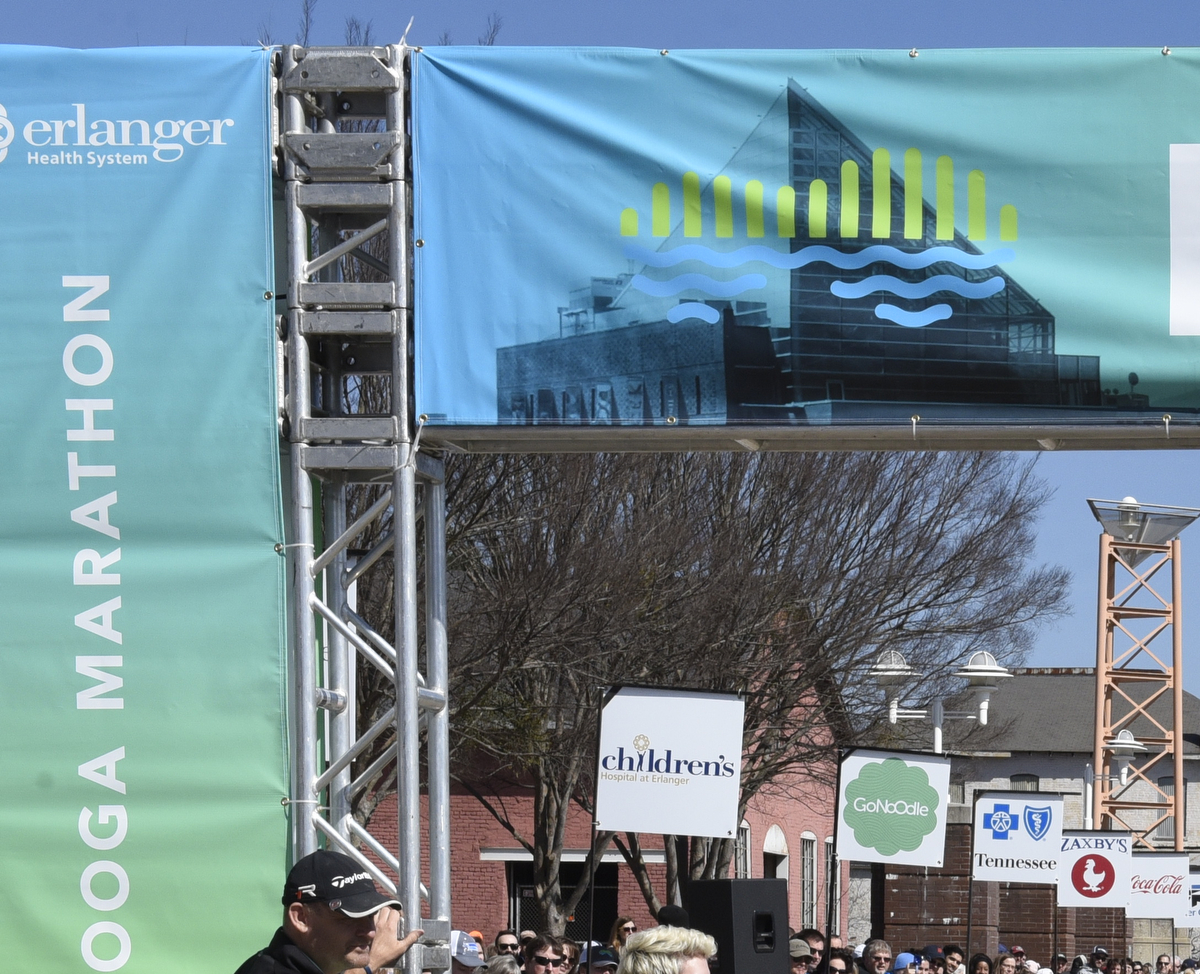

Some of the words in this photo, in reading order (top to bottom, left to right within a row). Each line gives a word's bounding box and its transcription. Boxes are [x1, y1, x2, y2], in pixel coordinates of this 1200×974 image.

[23, 103, 235, 163] erlanger
[27, 151, 83, 165] Health
[87, 151, 148, 168] System
[62, 275, 126, 710] MARATHON
[602, 746, 735, 778] children's
[600, 771, 637, 783] Hospital
[640, 773, 649, 783] at
[651, 775, 690, 787] Erlanger
[1061, 837, 1128, 853] ZAXBY'S
[975, 852, 1057, 871] Tennessee
